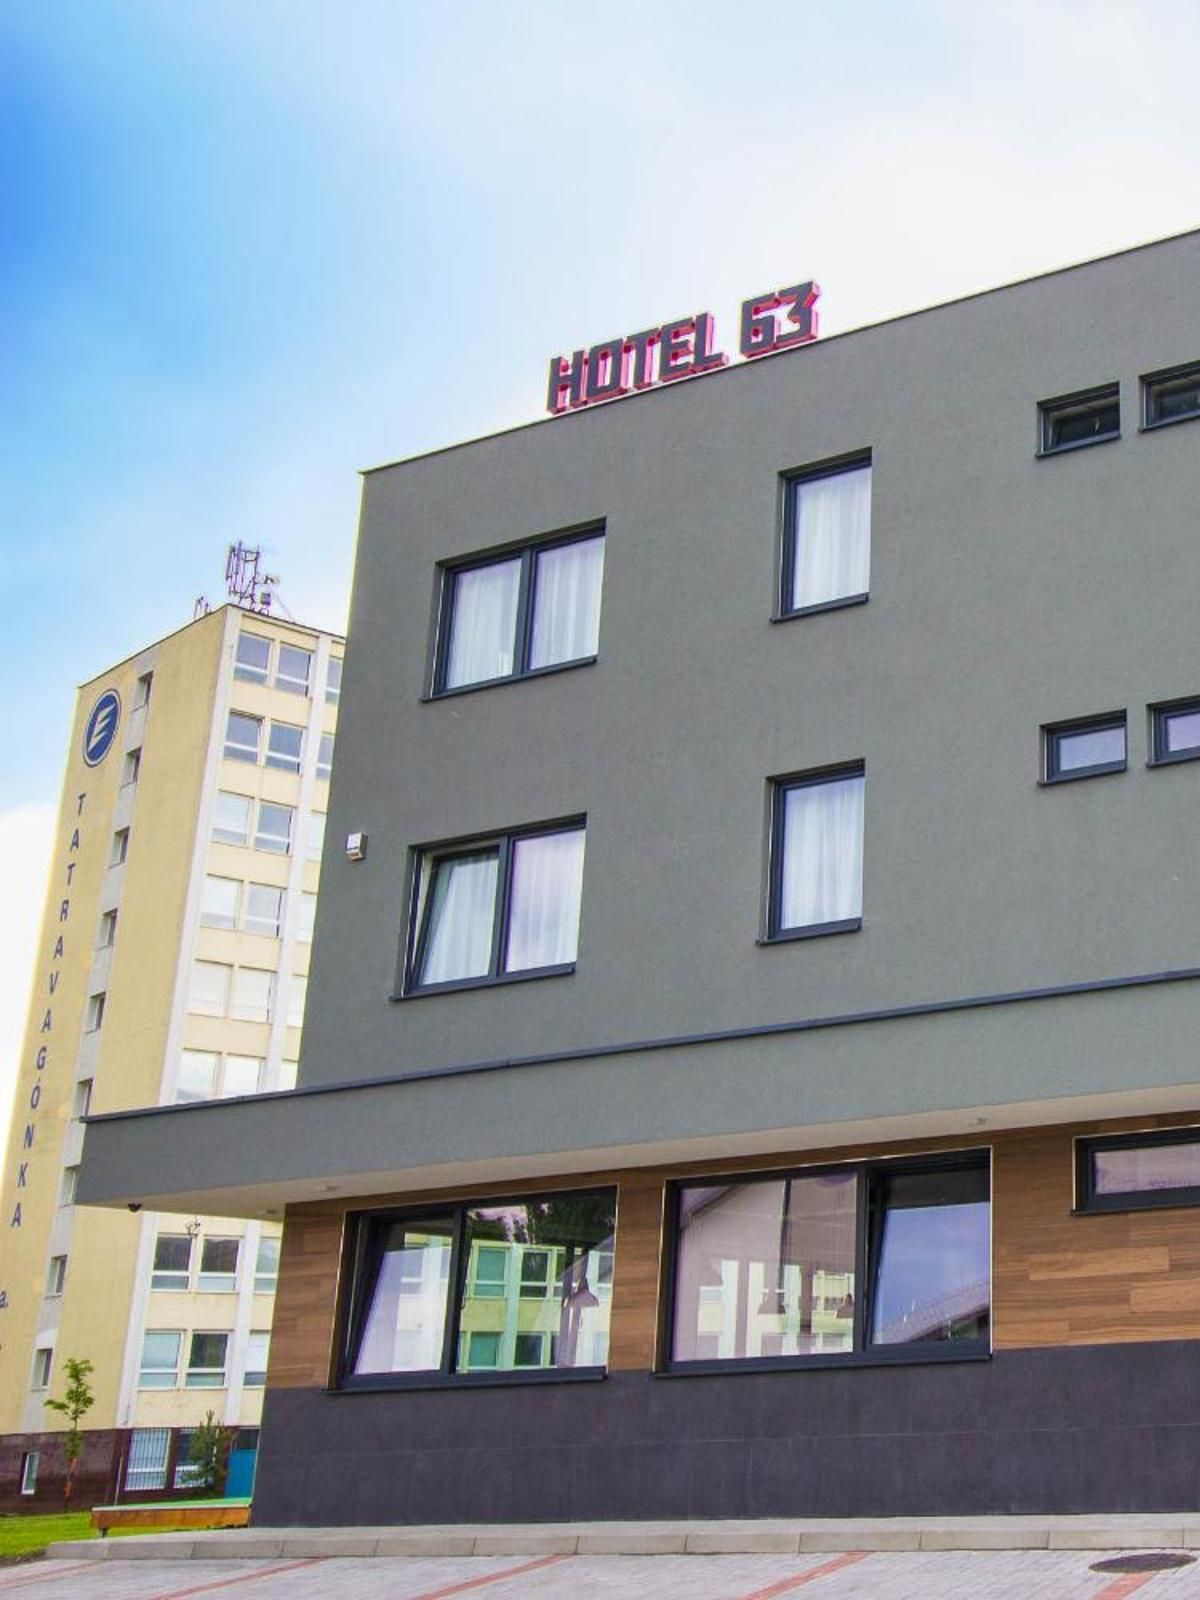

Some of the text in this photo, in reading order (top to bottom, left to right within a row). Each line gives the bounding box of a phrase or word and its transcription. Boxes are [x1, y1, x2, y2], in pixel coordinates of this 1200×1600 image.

[548, 280, 820, 414] HOTEL 63
[11, 792, 86, 1228] TATRAVAGÓNKA
